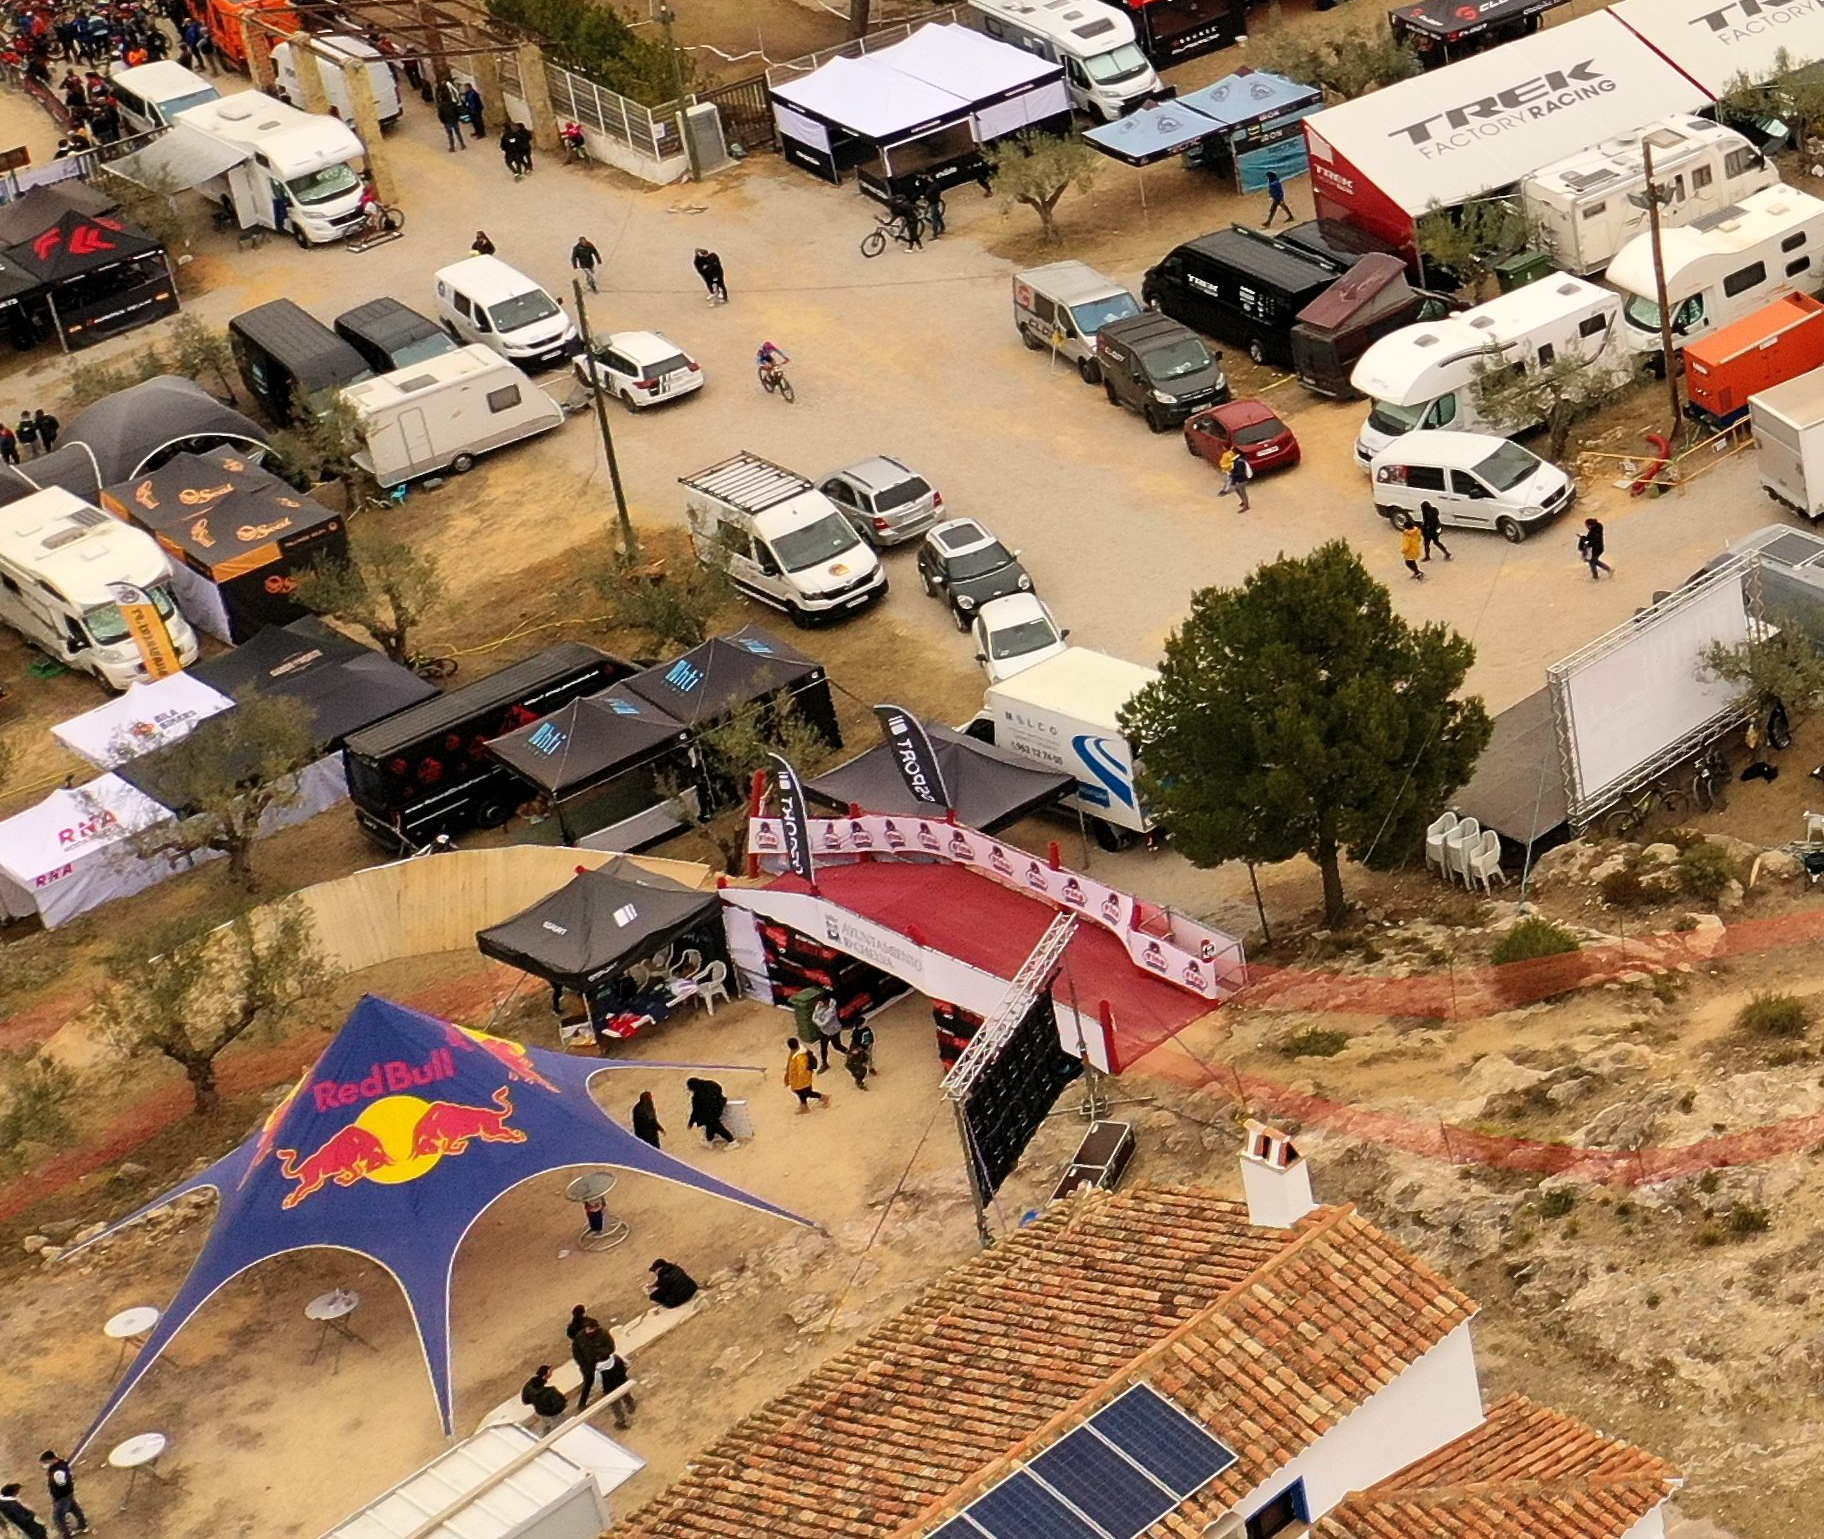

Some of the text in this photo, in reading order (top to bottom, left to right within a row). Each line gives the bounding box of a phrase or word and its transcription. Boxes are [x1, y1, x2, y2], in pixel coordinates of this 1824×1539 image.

[1718, 0, 1817, 46] FACTORY
[1387, 57, 1605, 146] TREK
[1418, 79, 1617, 161] FACTORY RACING
[314, 1047, 457, 1113] Red Bull
